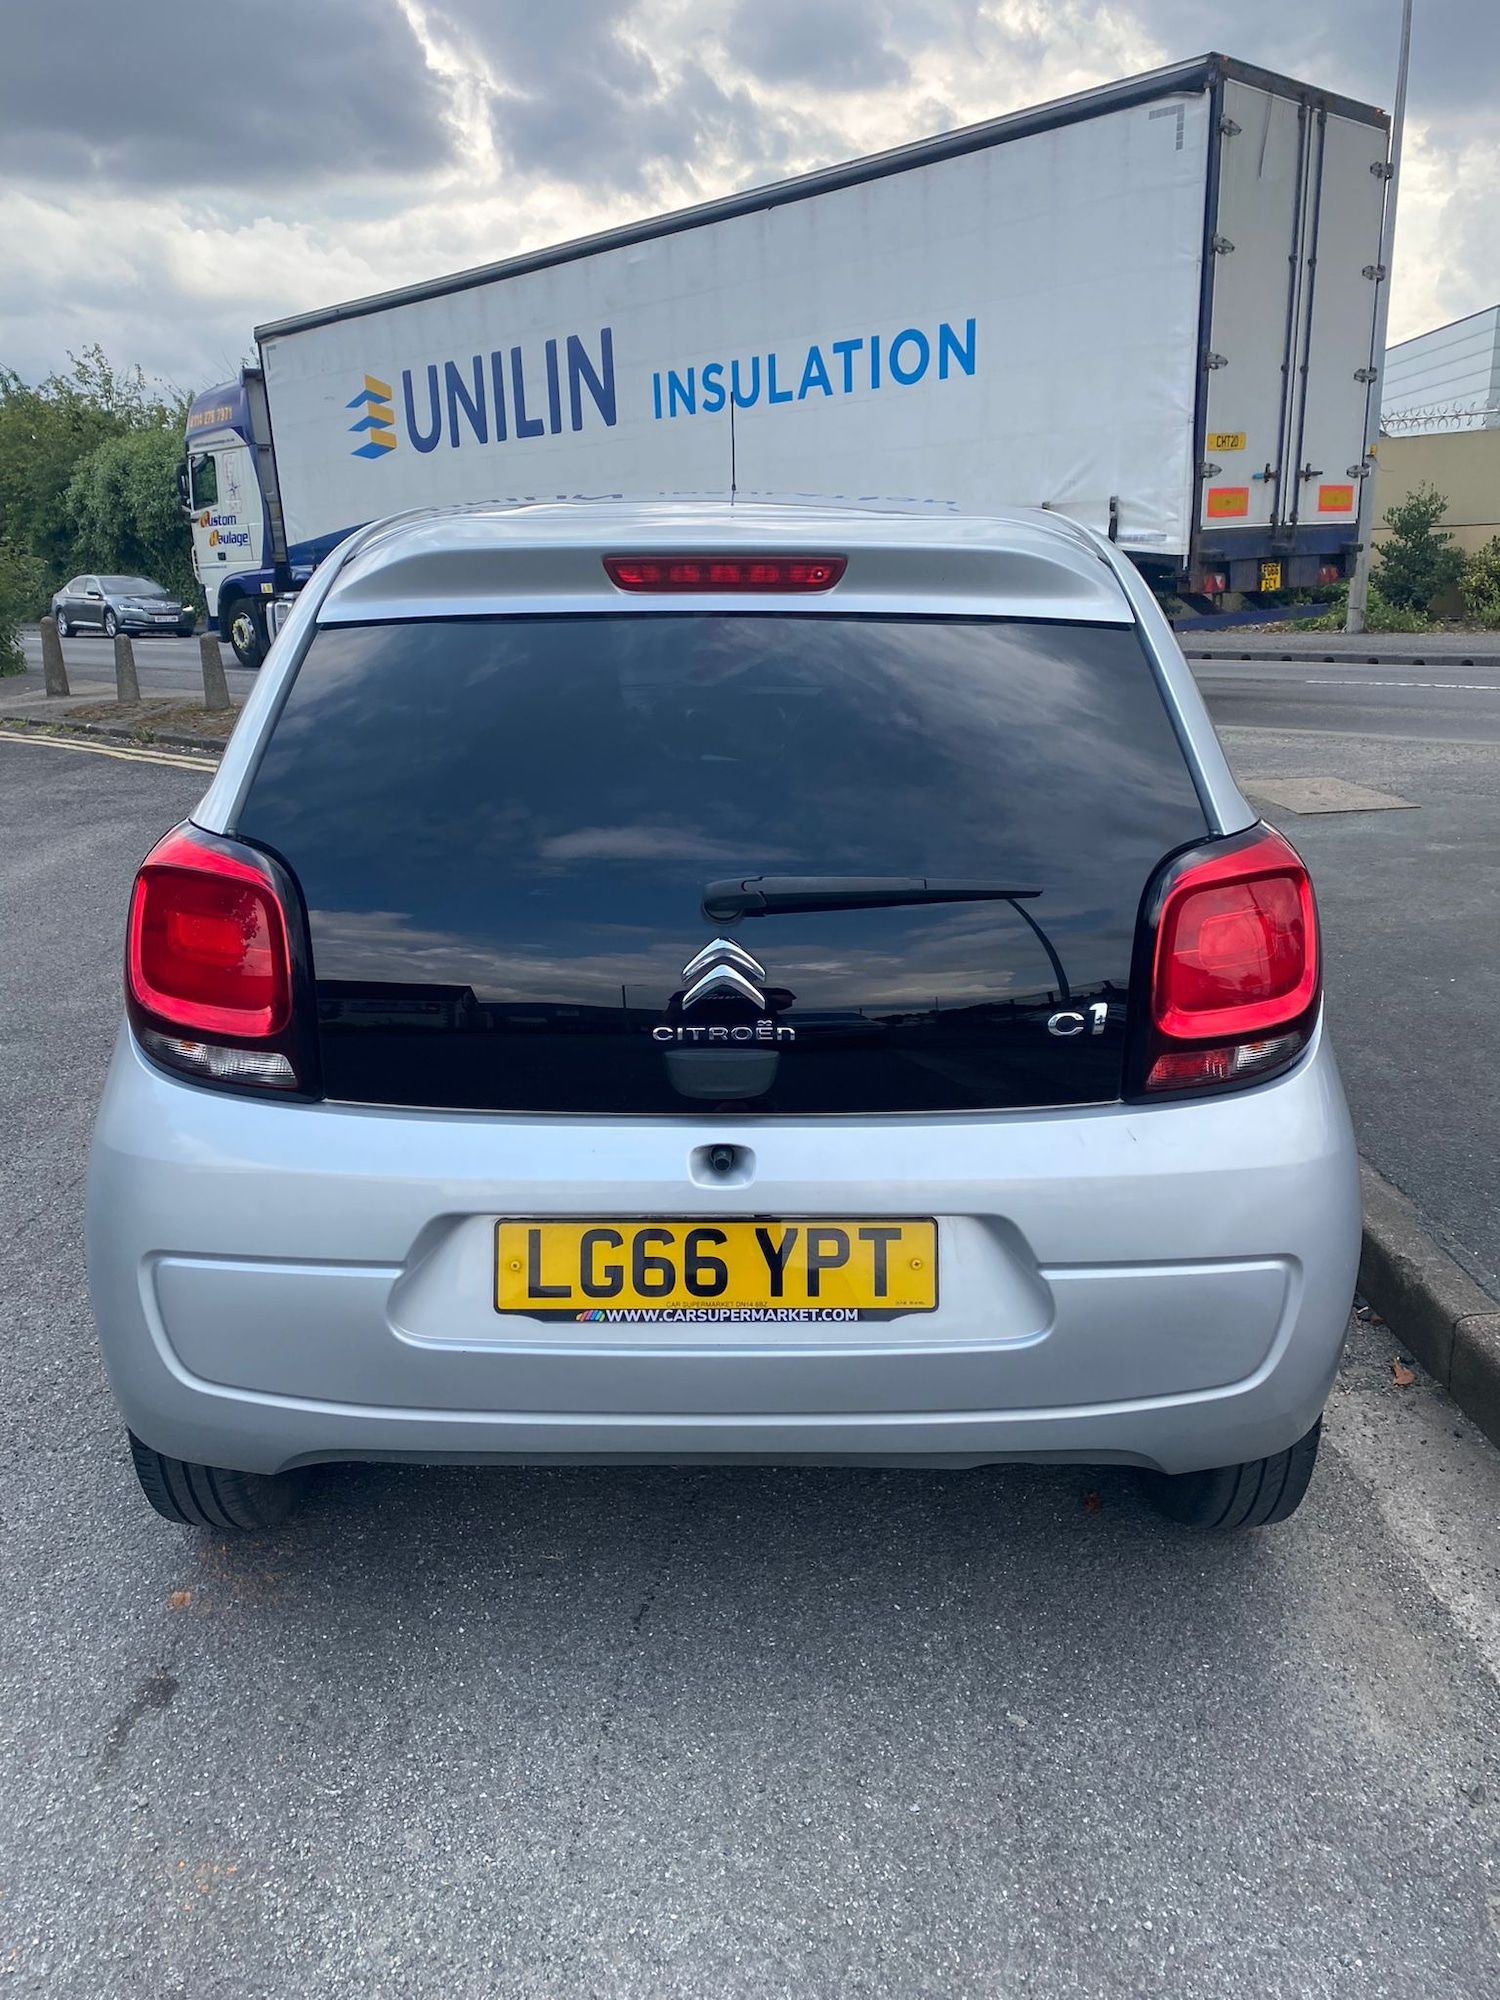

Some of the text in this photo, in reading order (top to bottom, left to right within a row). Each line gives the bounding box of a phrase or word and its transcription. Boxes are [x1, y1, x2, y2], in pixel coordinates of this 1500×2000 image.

[402, 318, 977, 454] UNILIN INSULATION
[1216, 435, 1239, 448] CHT20
[200, 510, 237, 528] Custom
[209, 529, 249, 547] Haulage
[1047, 1002, 1108, 1037] C1
[527, 1228, 902, 1298] LG66 YPT
[606, 1308, 859, 1322] WWW.CARSUPERMARKET.COM
